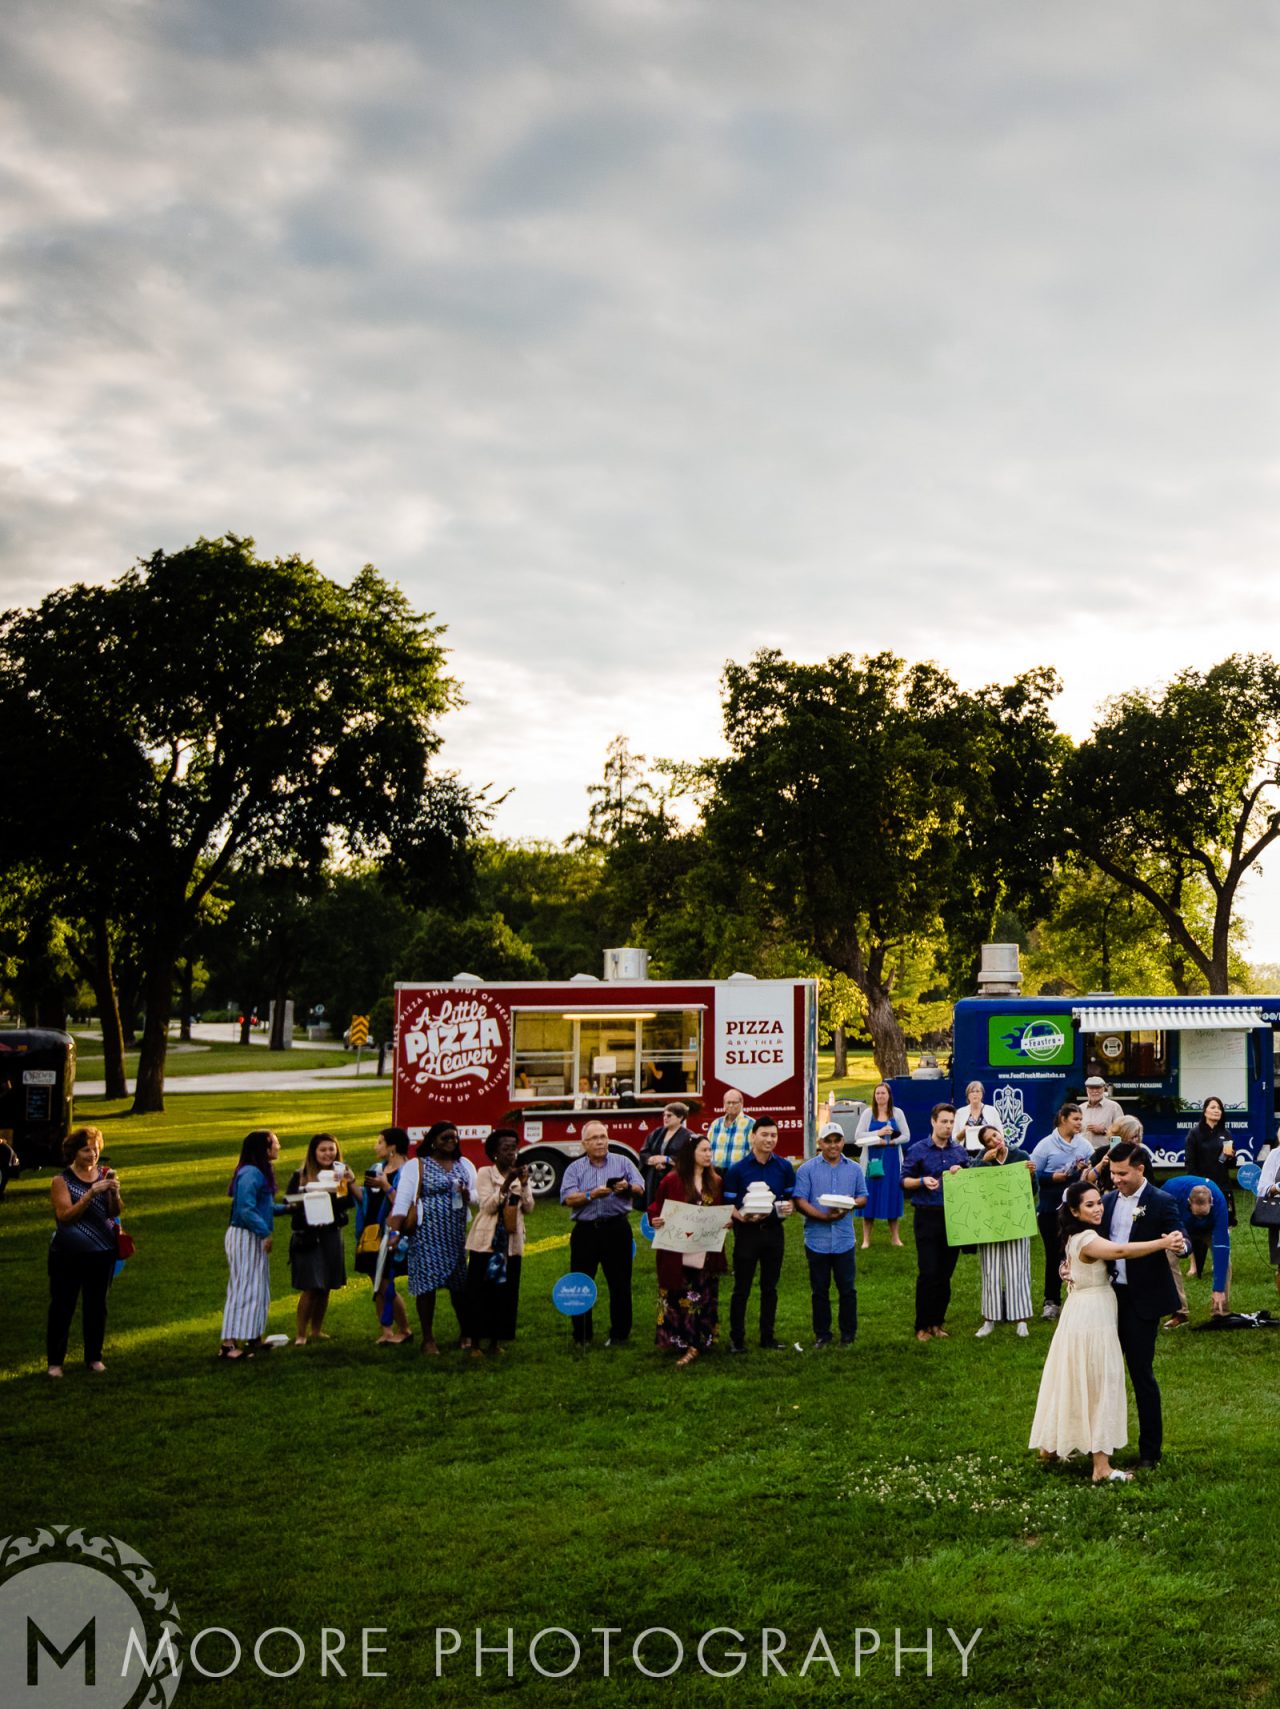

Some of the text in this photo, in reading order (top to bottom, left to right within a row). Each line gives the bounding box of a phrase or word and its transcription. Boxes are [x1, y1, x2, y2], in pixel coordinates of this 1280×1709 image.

[400, 997, 423, 1021] PIZZA
[410, 1000, 487, 1032] A Little
[726, 1020, 784, 1035] PIZZA
[404, 1018, 503, 1065] PIZZA
[419, 1048, 498, 1076] Heaven
[726, 1049, 784, 1065] SLICE
[410, 1084, 421, 1094] IN
[428, 1092, 452, 1103] PICK
[457, 1093, 471, 1102] UP
[612, 1122, 633, 1130] HERE
[1231, 1121, 1248, 1129] TRUCK
